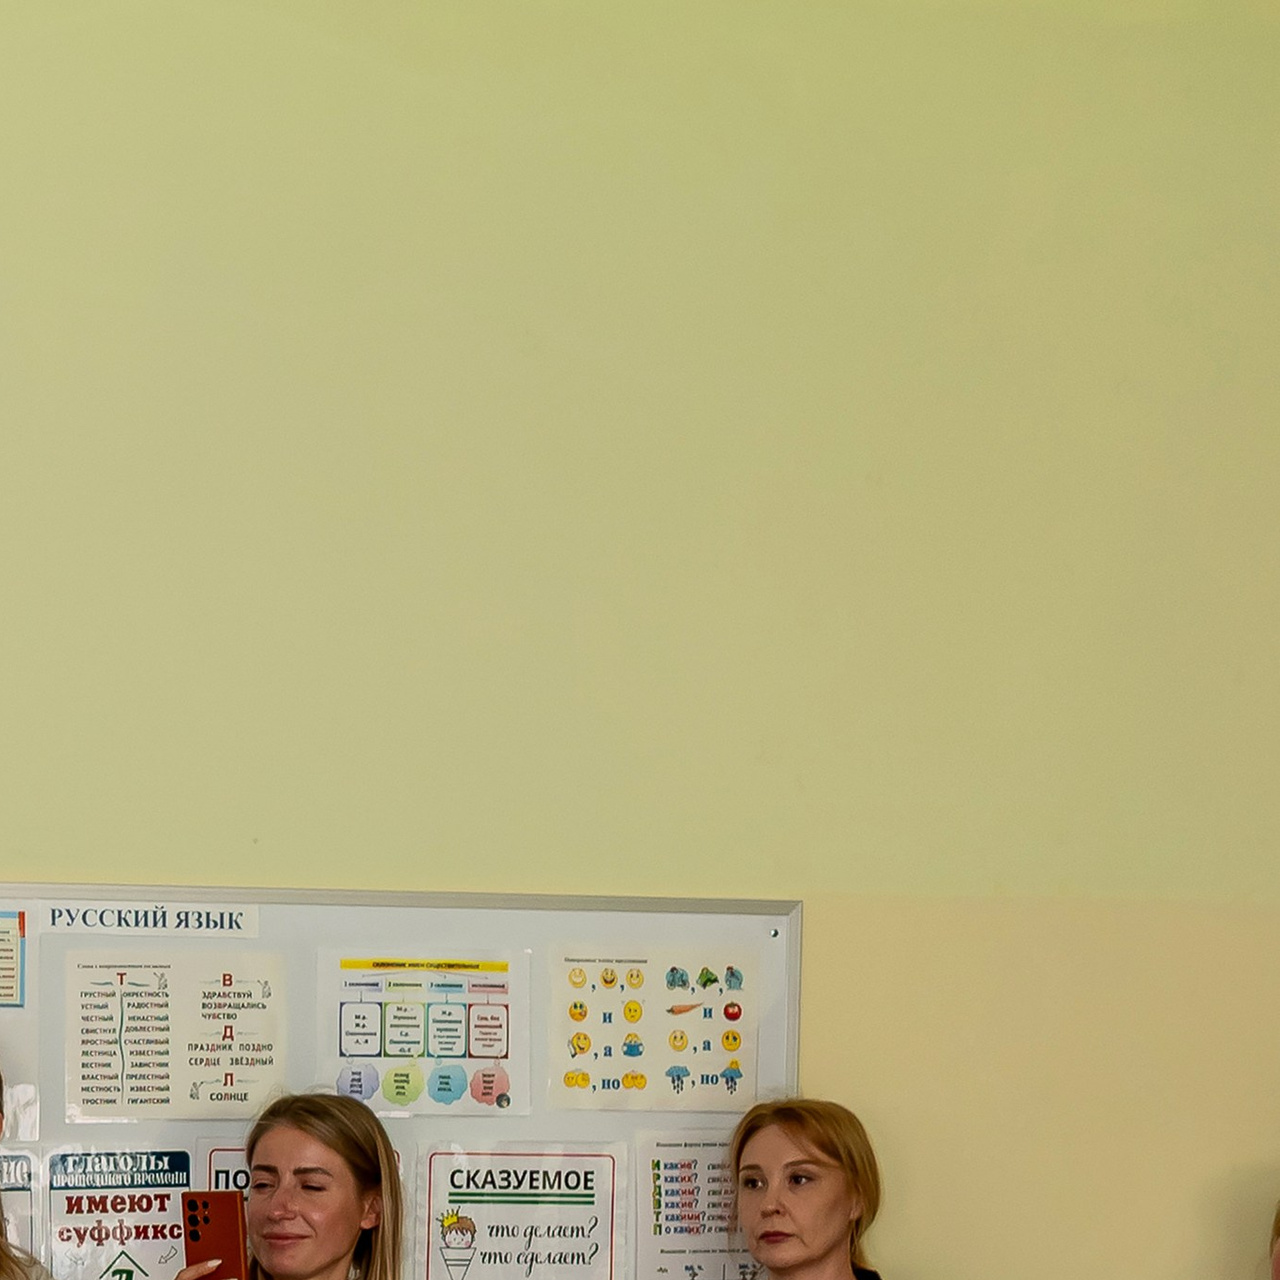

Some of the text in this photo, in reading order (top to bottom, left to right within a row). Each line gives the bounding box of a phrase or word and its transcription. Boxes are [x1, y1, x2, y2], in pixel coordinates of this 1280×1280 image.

[51, 905, 244, 931] РУССКИЙ ЯЗЫК
[116, 972, 127, 985] Т
[222, 973, 233, 987] В
[202, 990, 252, 999] ЗДРАВСТВУЙ
[201, 1002, 267, 1010] ВОЗВРАЩАЛИСЬ
[222, 1025, 234, 1041] Д
[188, 1043, 273, 1053] ПРАЗДНИК ПОЗДНО
[188, 1055, 274, 1067] СЕРДЦЕ ЗВЁЗДНЫЙ
[223, 1073, 234, 1087] Л
[209, 1092, 249, 1102] СОЛНЦЕ
[449, 1169, 595, 1190] СКАЗУЕМОЕ
[65, 1193, 170, 1214] имеют
[58, 1219, 183, 1247] суффикс
[487, 1215, 598, 1250] что делает?
[480, 1242, 599, 1278] что сделает?
